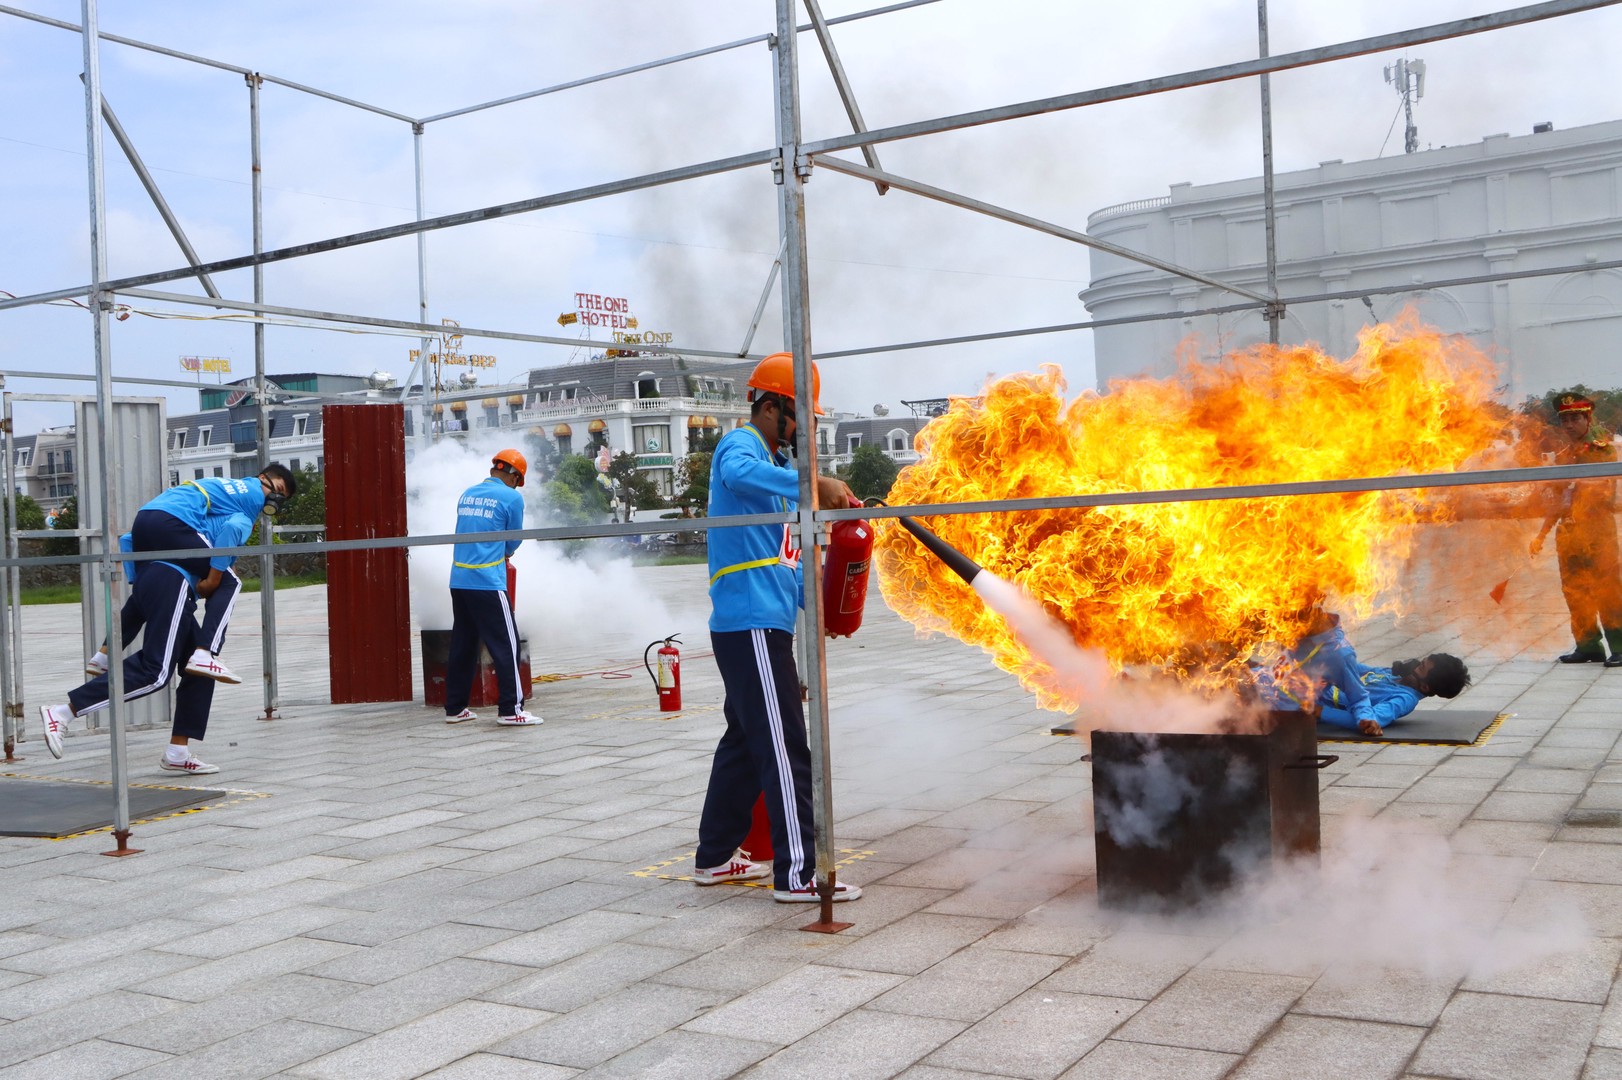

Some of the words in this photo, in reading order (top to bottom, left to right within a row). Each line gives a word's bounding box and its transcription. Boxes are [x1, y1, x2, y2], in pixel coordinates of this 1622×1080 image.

[576, 292, 602, 310] THE
[603, 296, 628, 313] ONE
[581, 311, 627, 329] HOTEL
[643, 330, 672, 343] ONE
[483, 498, 498, 508] PCCC
